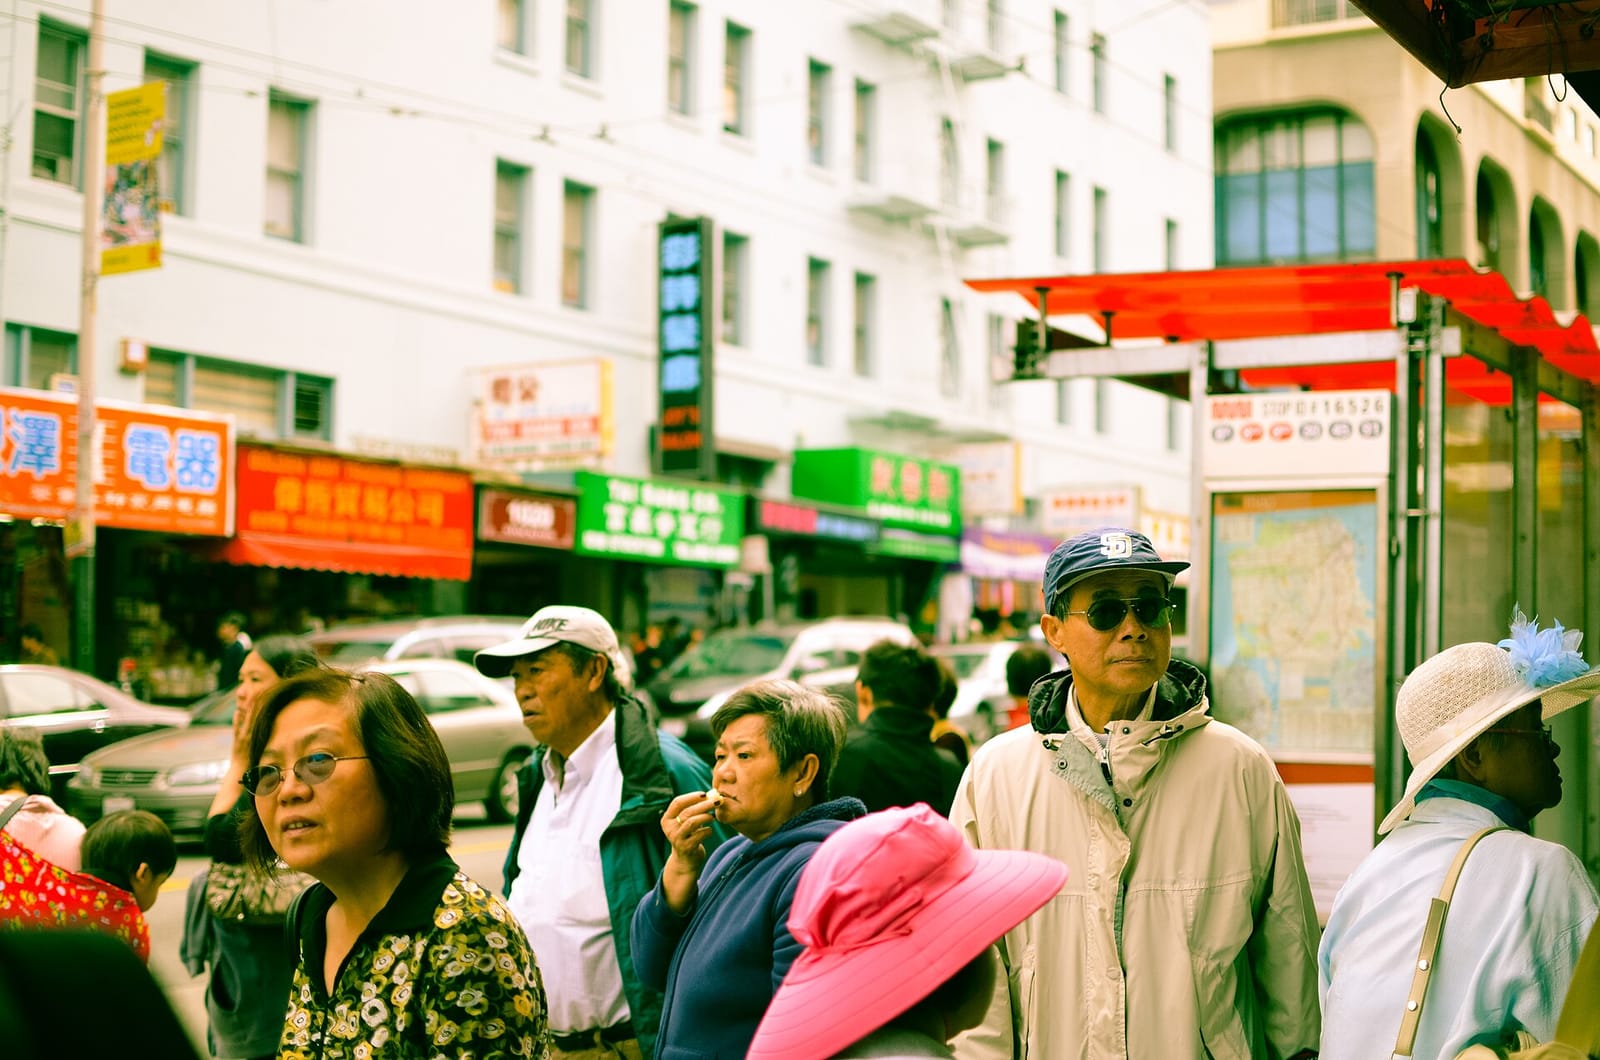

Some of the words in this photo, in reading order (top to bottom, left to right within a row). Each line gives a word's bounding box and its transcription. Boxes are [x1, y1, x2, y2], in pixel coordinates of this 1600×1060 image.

[0, 407, 61, 478] 澤
[124, 423, 221, 494] 電器
[1100, 533, 1132, 559] SD
[533, 618, 569, 632] NIKE
